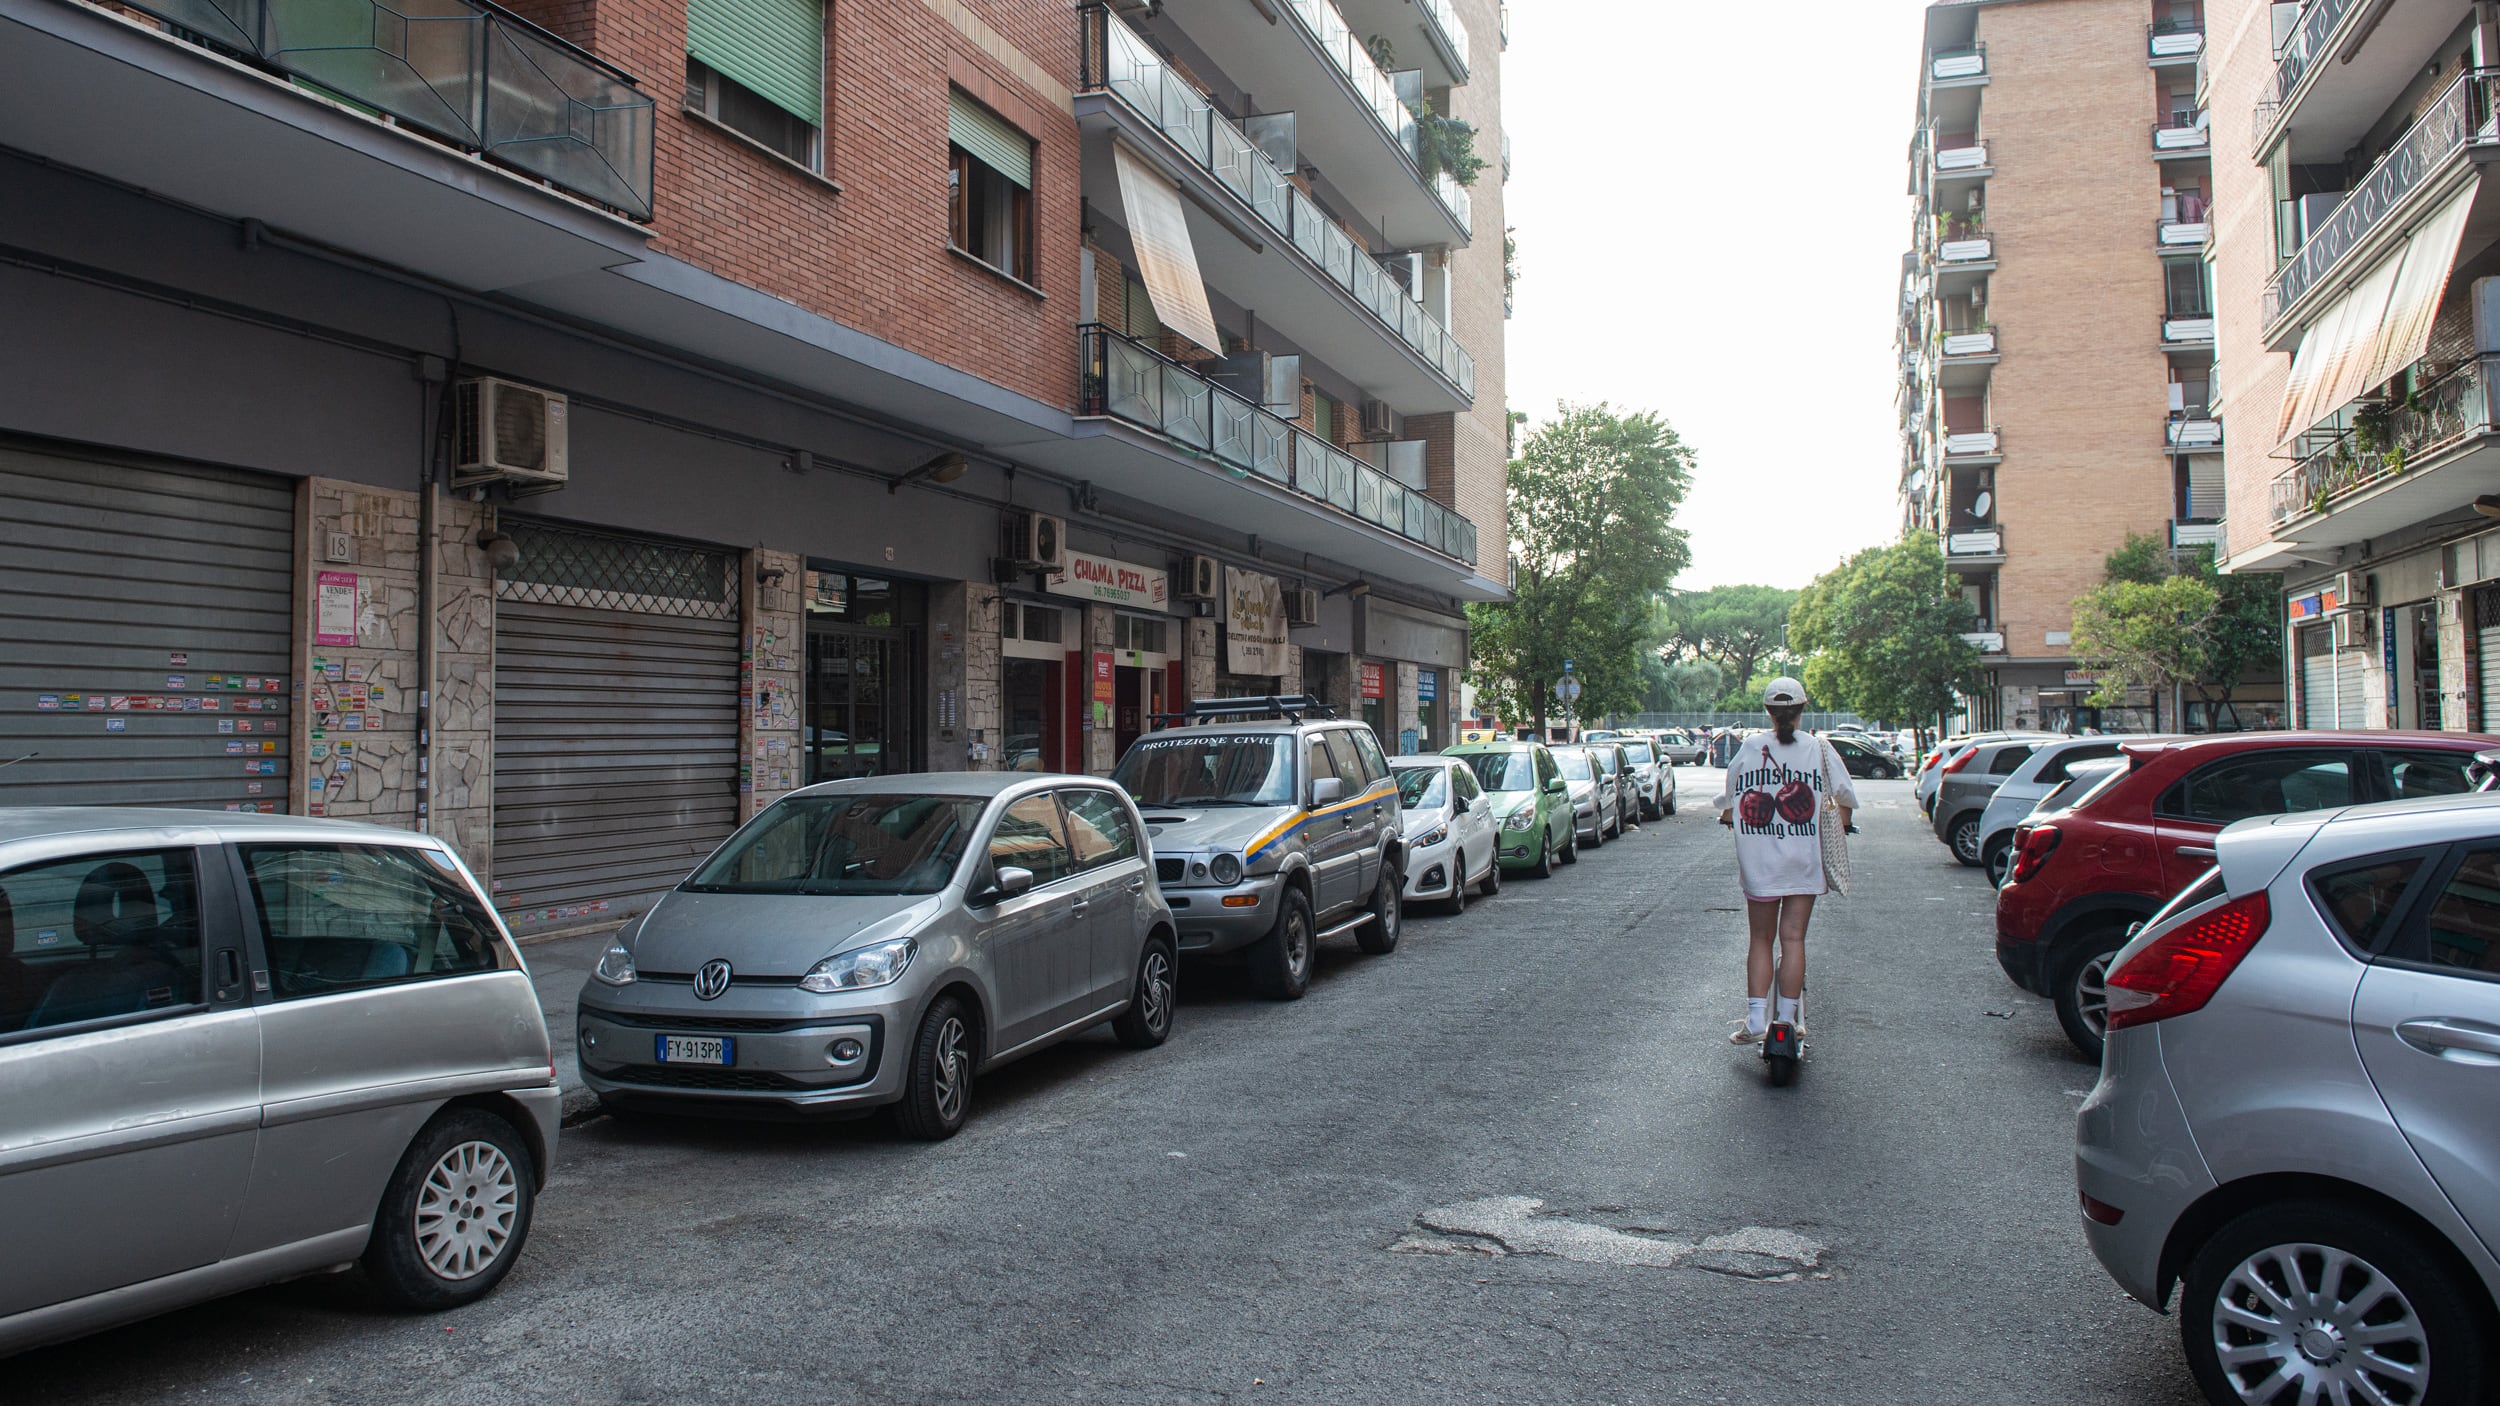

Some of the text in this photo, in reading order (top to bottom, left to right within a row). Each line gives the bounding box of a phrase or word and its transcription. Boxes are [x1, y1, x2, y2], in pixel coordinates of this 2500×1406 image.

[331, 537, 346, 556] 18
[1074, 559, 1147, 593] CHIAMA PIZZA
[1142, 736, 1228, 751] PROTEZIONE
[1735, 763, 1823, 796] gymshark
